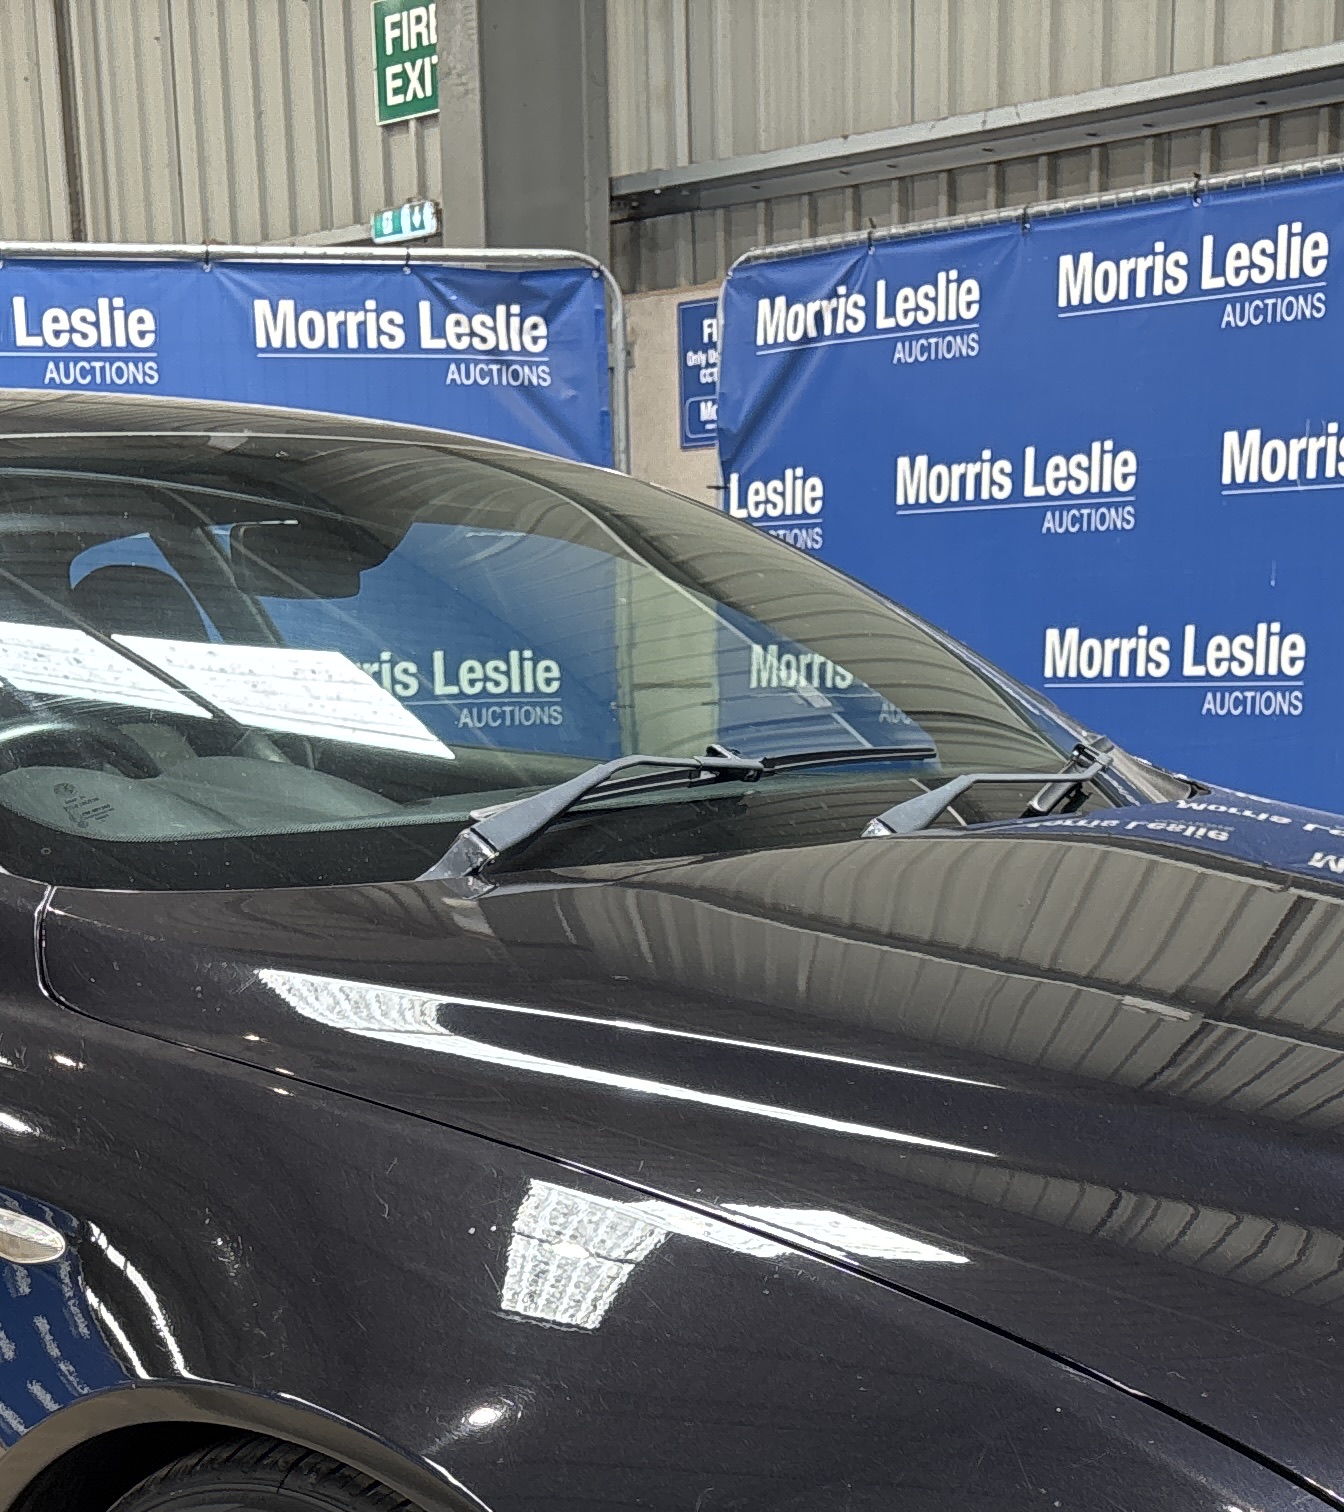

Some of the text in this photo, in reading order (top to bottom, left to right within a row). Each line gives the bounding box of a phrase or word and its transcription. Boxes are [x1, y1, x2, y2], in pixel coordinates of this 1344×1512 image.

[385, 54, 438, 106] EXI
[1058, 221, 1329, 308] Morris Leslie
[12, 296, 156, 348] Leslie
[253, 299, 548, 353] Morris Leslie
[756, 268, 980, 346] Morris Leslie
[1220, 292, 1326, 329] AUCTIONS
[43, 360, 159, 385] AUCTIONS
[892, 332, 979, 364] AUCTIONS
[445, 362, 552, 387] AUCTIONS
[729, 467, 824, 519] Leslie
[896, 439, 1137, 506] Morris Leslie
[1041, 505, 1135, 534] AUCTIONS
[433, 649, 561, 695] Leslie
[1044, 621, 1306, 679] Morris Leslie
[457, 705, 563, 728] AUCTIONS
[1201, 690, 1303, 716] AUCTIONS
